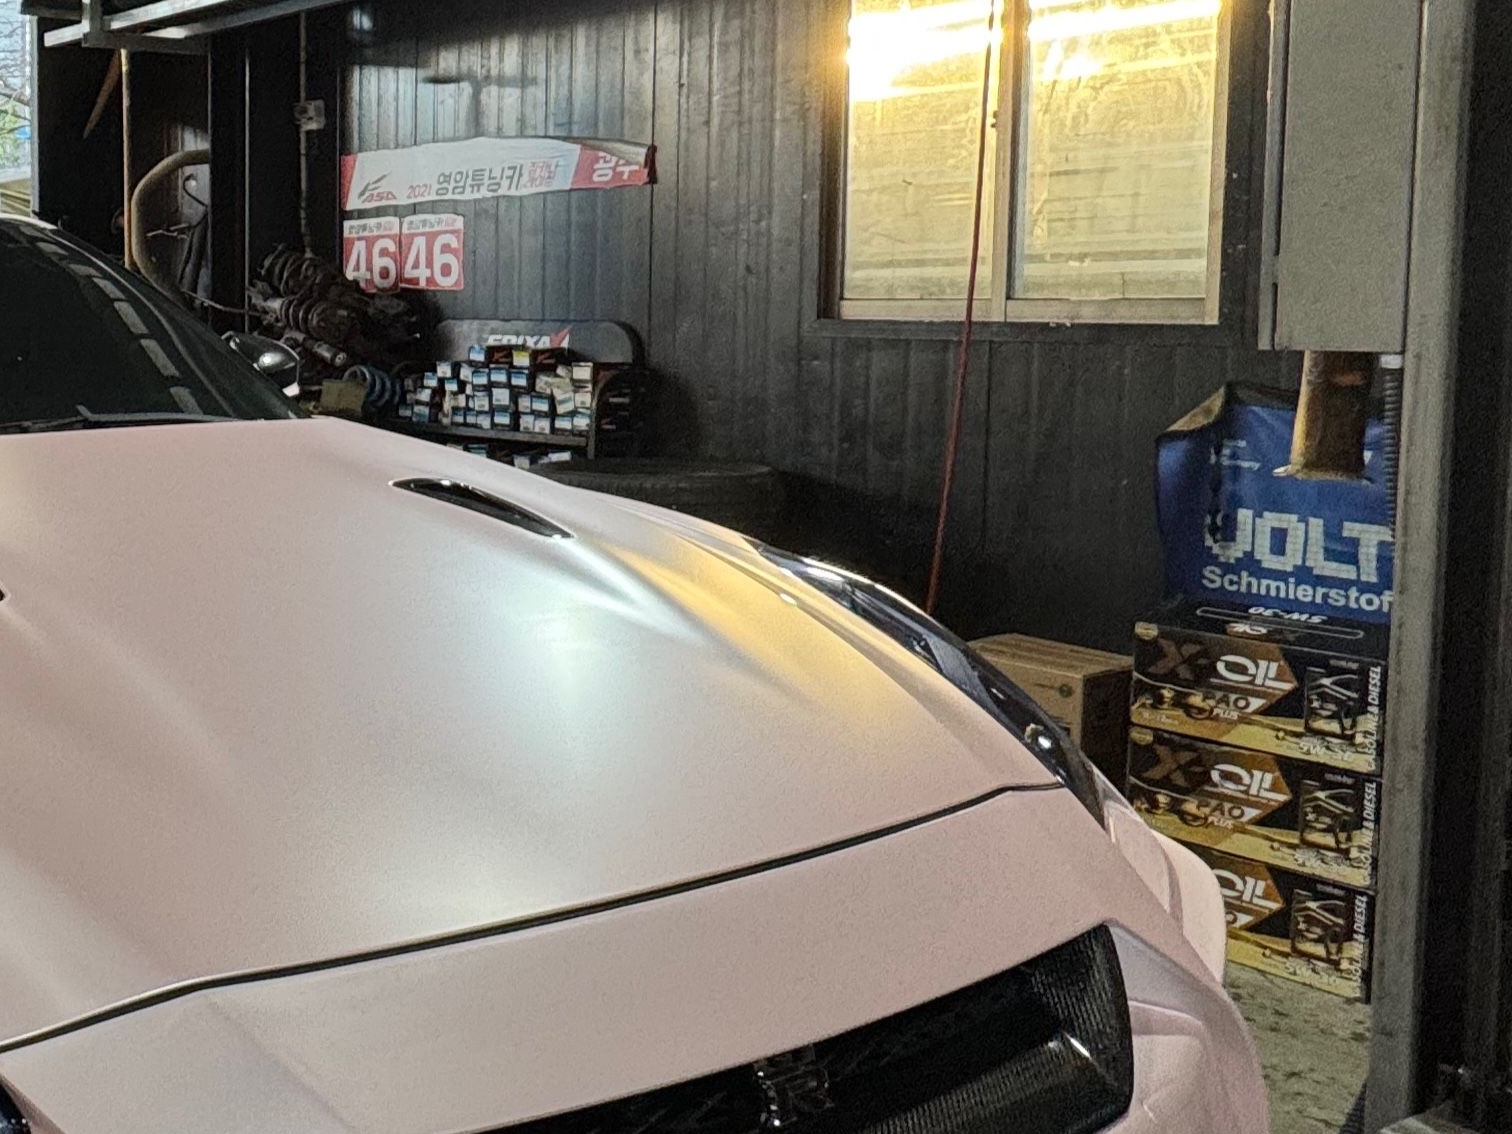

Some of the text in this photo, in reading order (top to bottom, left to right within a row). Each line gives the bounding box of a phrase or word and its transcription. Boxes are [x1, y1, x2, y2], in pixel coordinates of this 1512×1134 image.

[406, 184, 432, 199] 2021
[435, 163, 523, 196] 영암튜닝카
[347, 238, 397, 289] 46
[404, 233, 460, 288] 46
[1368, 666, 1381, 704] DIESEL
[1363, 782, 1376, 820] DIESEL
[1353, 895, 1367, 933] DIESEL
